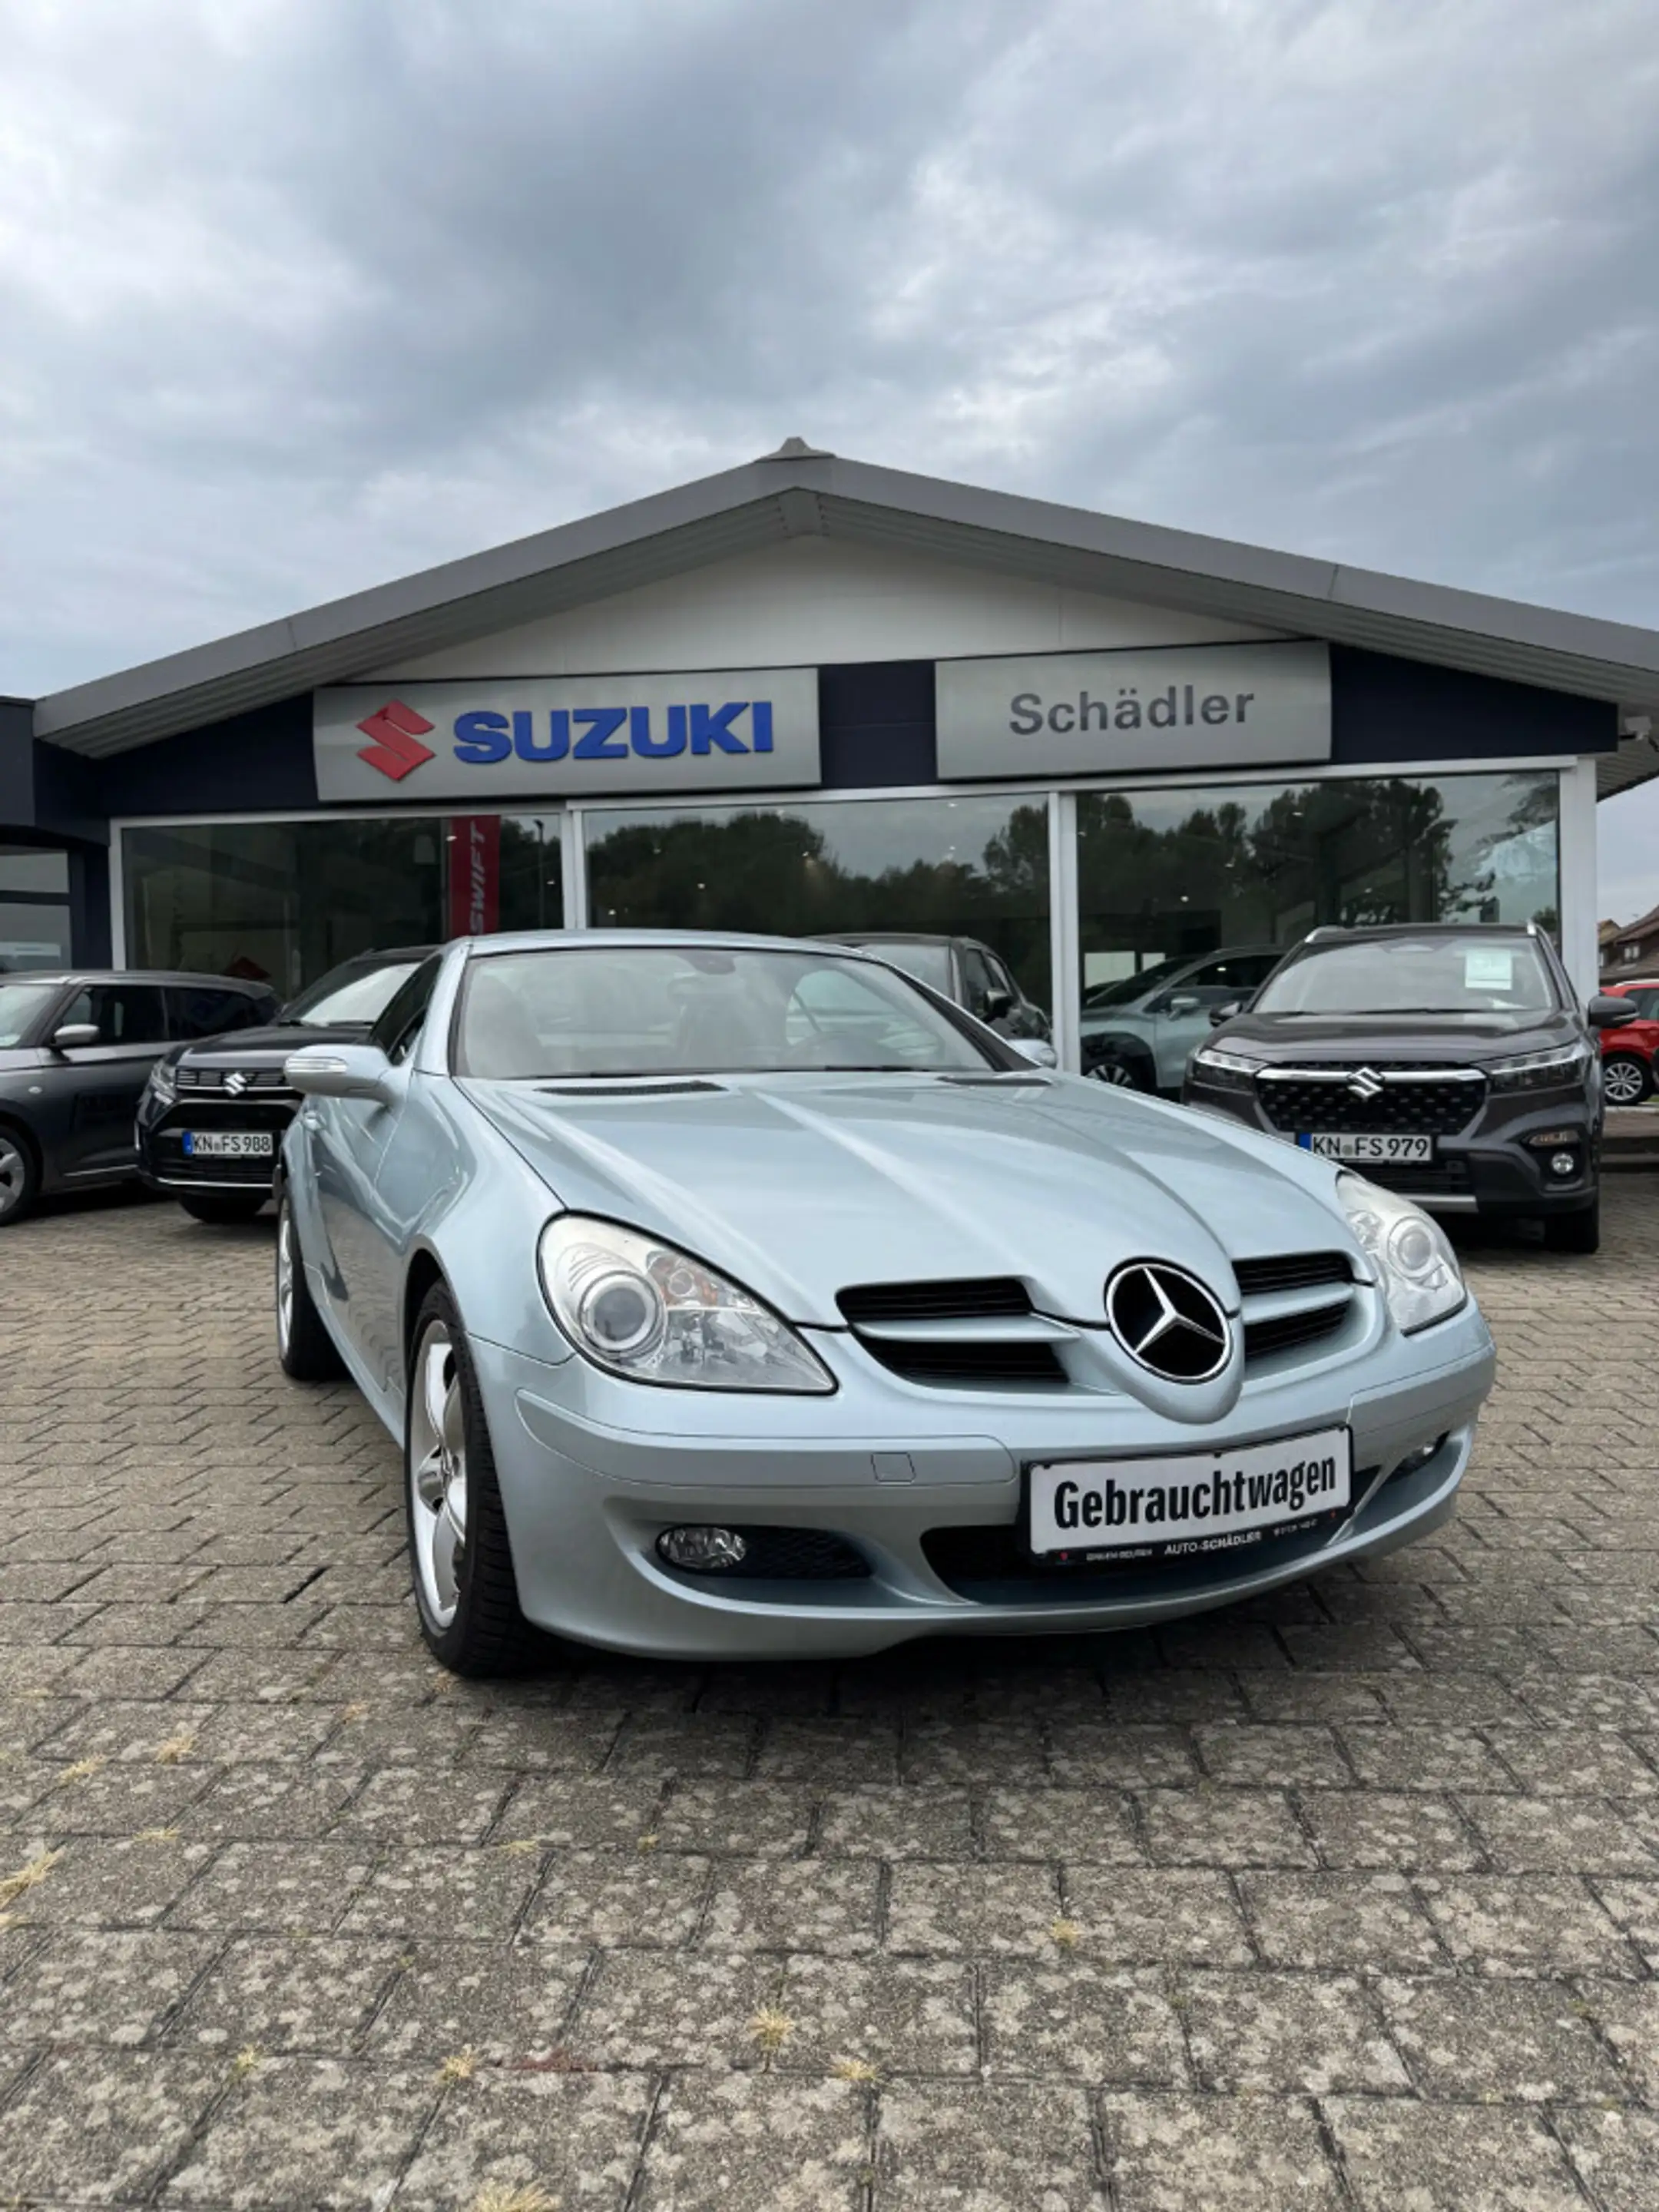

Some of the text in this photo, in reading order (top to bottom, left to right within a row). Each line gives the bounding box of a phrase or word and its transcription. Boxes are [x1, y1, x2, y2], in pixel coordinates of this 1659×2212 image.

[453, 700, 774, 763] SUZUKI
[1009, 684, 1254, 735] Schädler
[469, 820, 485, 935] SWIFT
[193, 1135, 213, 1152] KN
[1313, 1136, 1340, 1156] KN
[1055, 1456, 1336, 1529] Gebrauchtwagen
